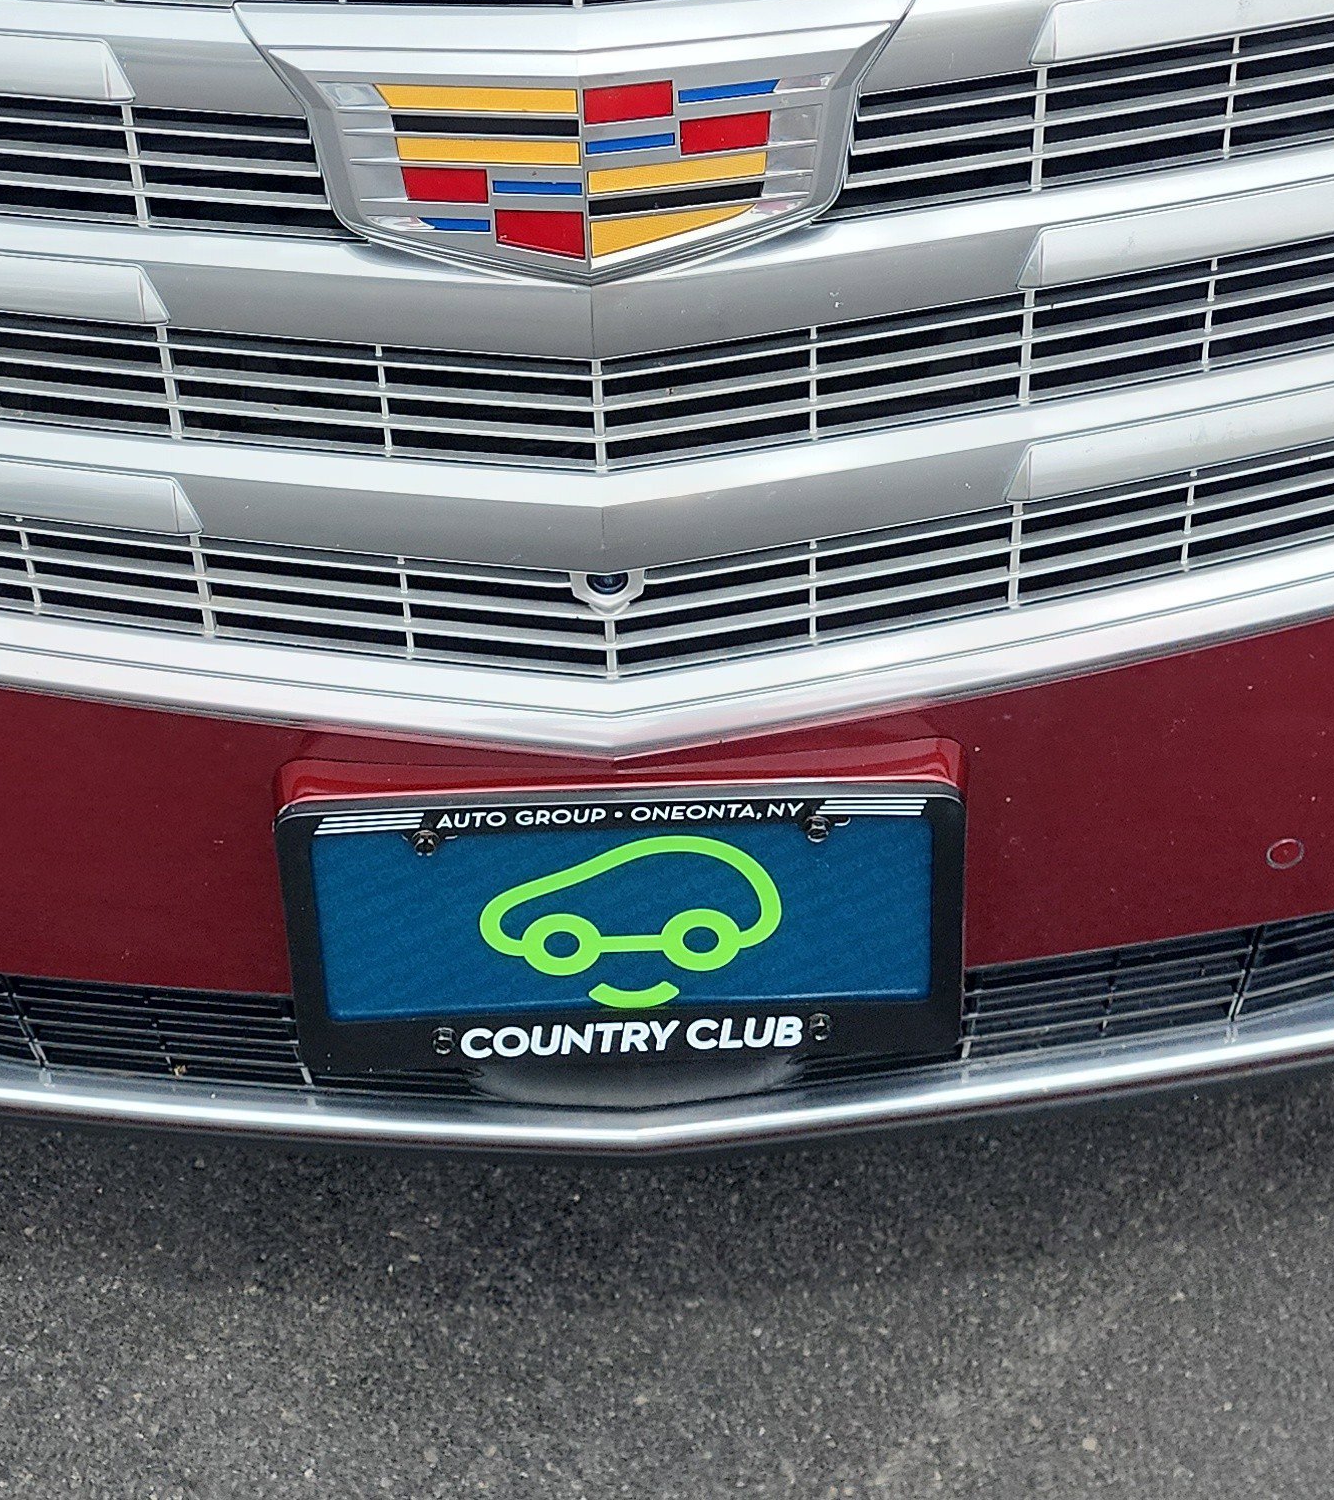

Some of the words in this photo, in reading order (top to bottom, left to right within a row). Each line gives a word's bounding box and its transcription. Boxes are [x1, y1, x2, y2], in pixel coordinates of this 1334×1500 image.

[435, 811, 507, 829] AUTO
[515, 807, 607, 826] GROUP
[766, 802, 805, 818] NY
[460, 1019, 681, 1059] COUNTRY
[685, 1015, 803, 1050] CLUB
